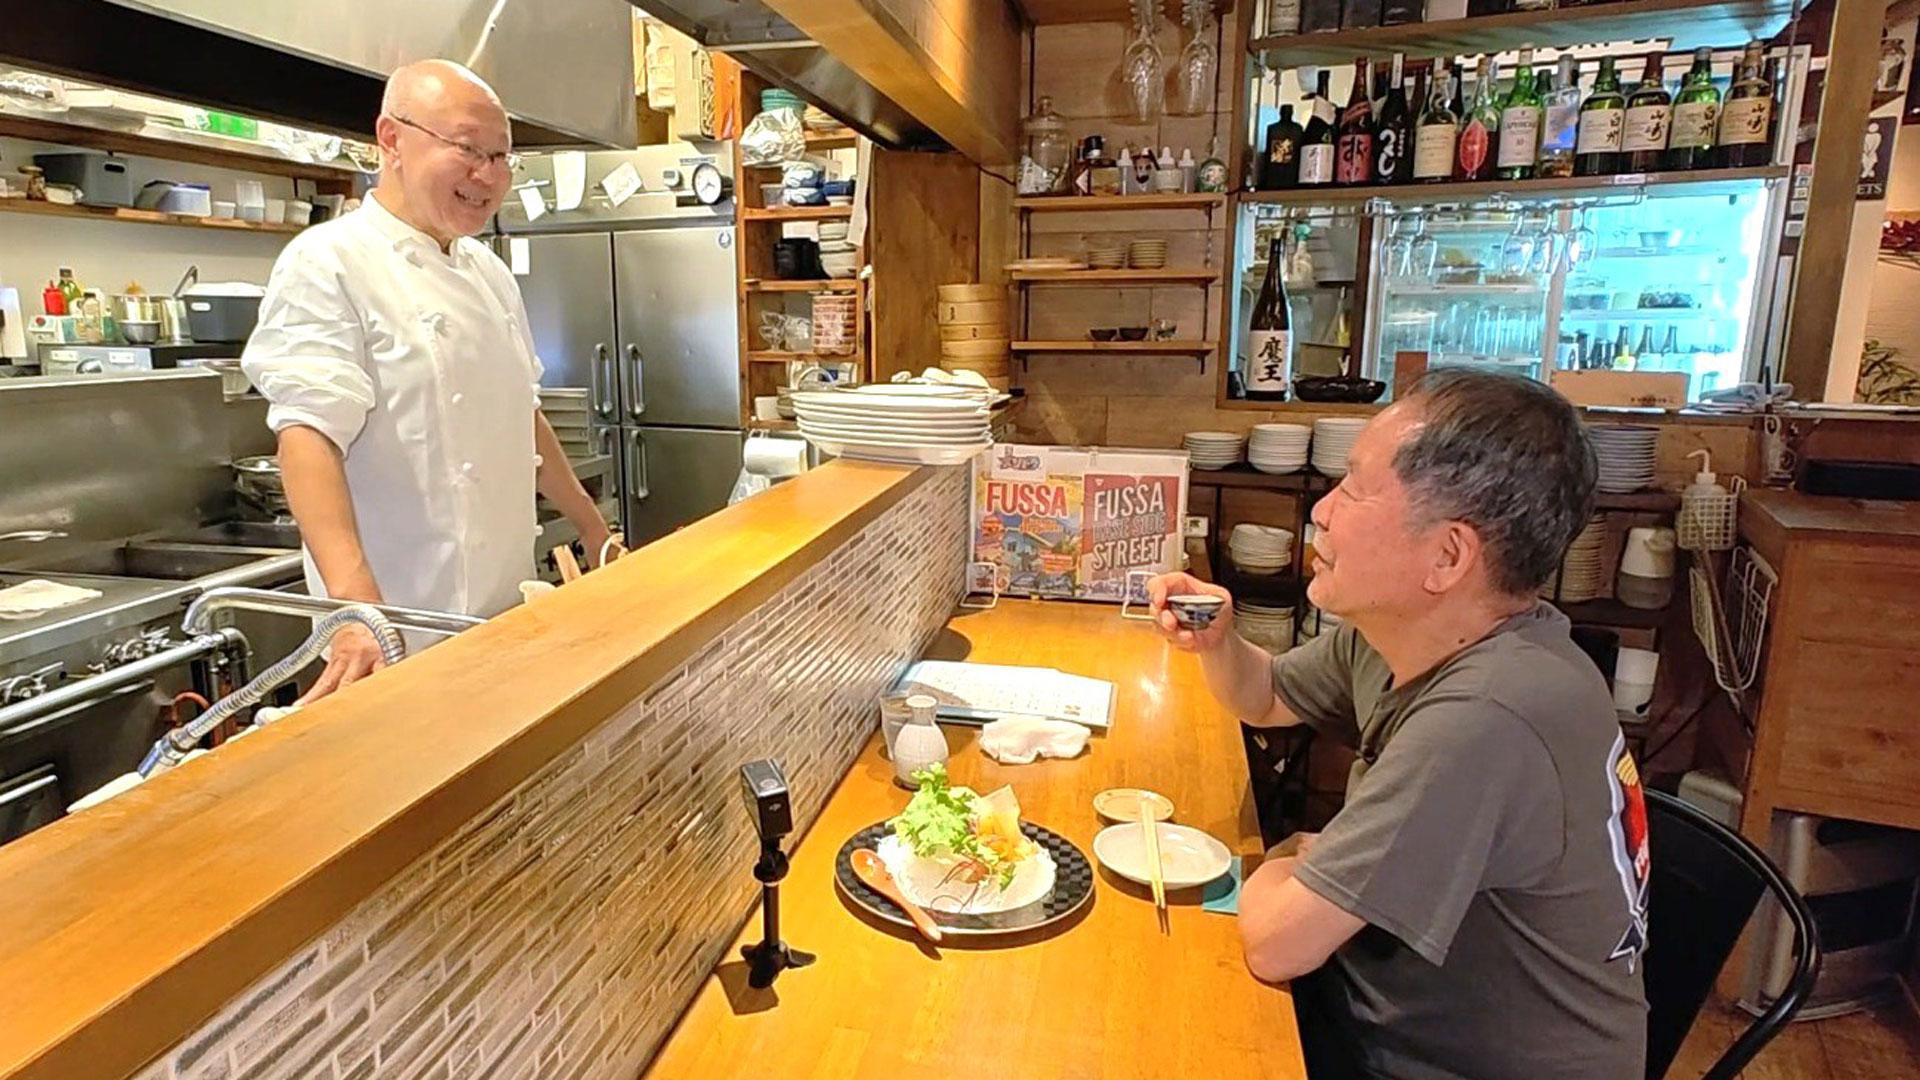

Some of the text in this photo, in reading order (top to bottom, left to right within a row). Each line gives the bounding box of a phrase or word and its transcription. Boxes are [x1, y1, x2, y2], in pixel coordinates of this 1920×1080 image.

[1606, 112, 1621, 146] 白州
[1645, 109, 1666, 142] 山崎
[1699, 105, 1716, 139] 白州
[1746, 103, 1765, 135] 山崎
[1257, 336, 1283, 383] 魔王
[986, 482, 1069, 517] FUSSA
[1094, 481, 1165, 522] FUSSA
[1092, 534, 1164, 571] STREET
